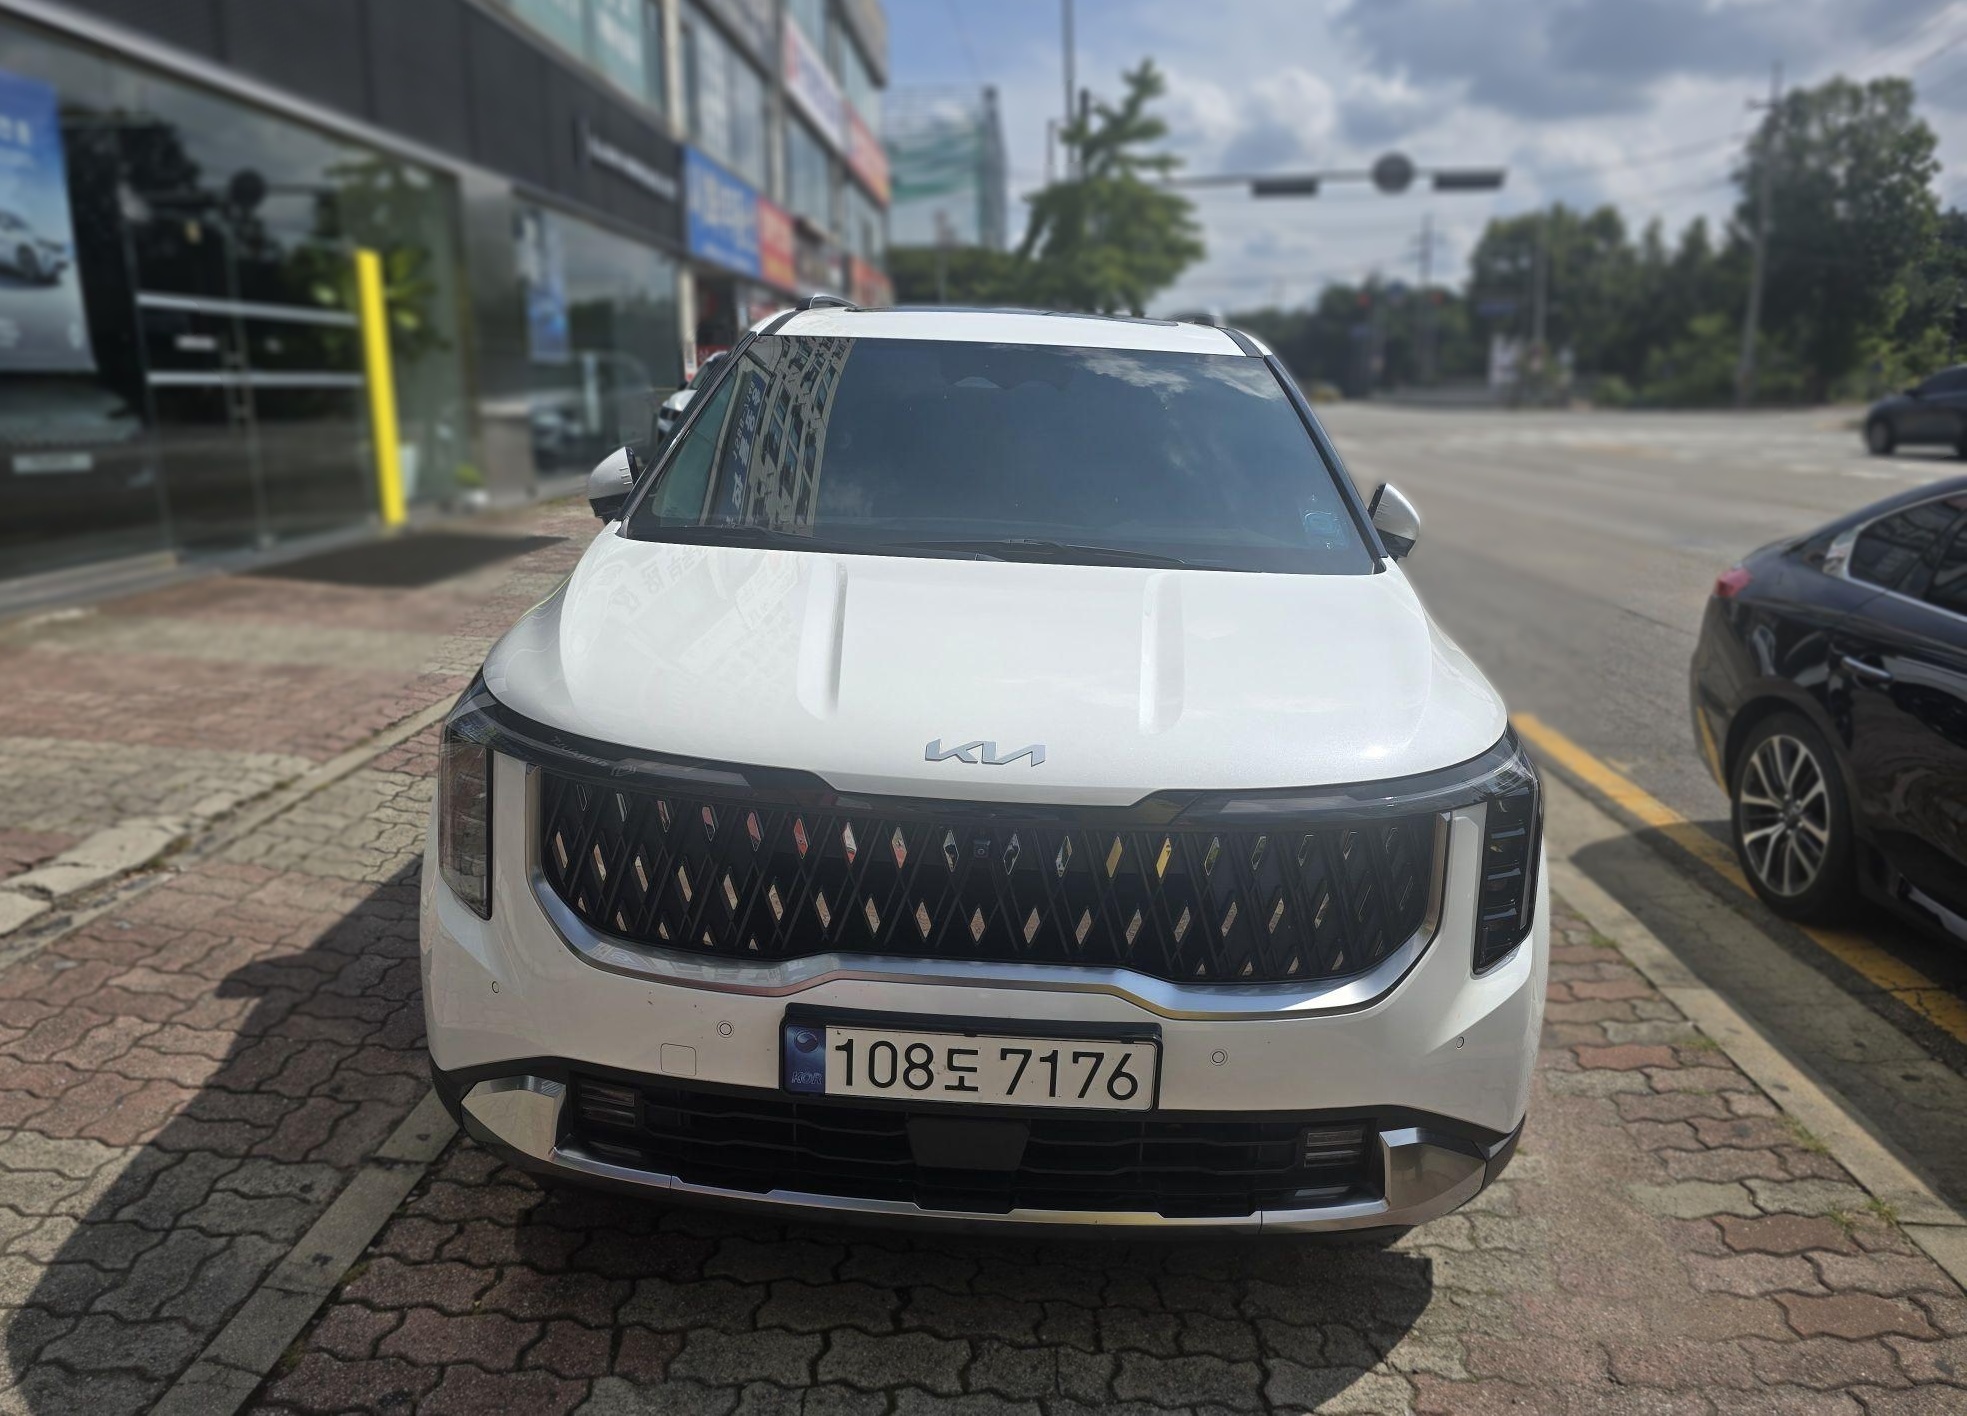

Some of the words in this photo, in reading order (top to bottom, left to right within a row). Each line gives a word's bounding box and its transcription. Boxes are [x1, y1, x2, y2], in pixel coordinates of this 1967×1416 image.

[925, 738, 1046, 767] KIA
[791, 1071, 823, 1085] KOR
[834, 1038, 979, 1092] 108도
[1000, 1048, 1139, 1101] 7176
